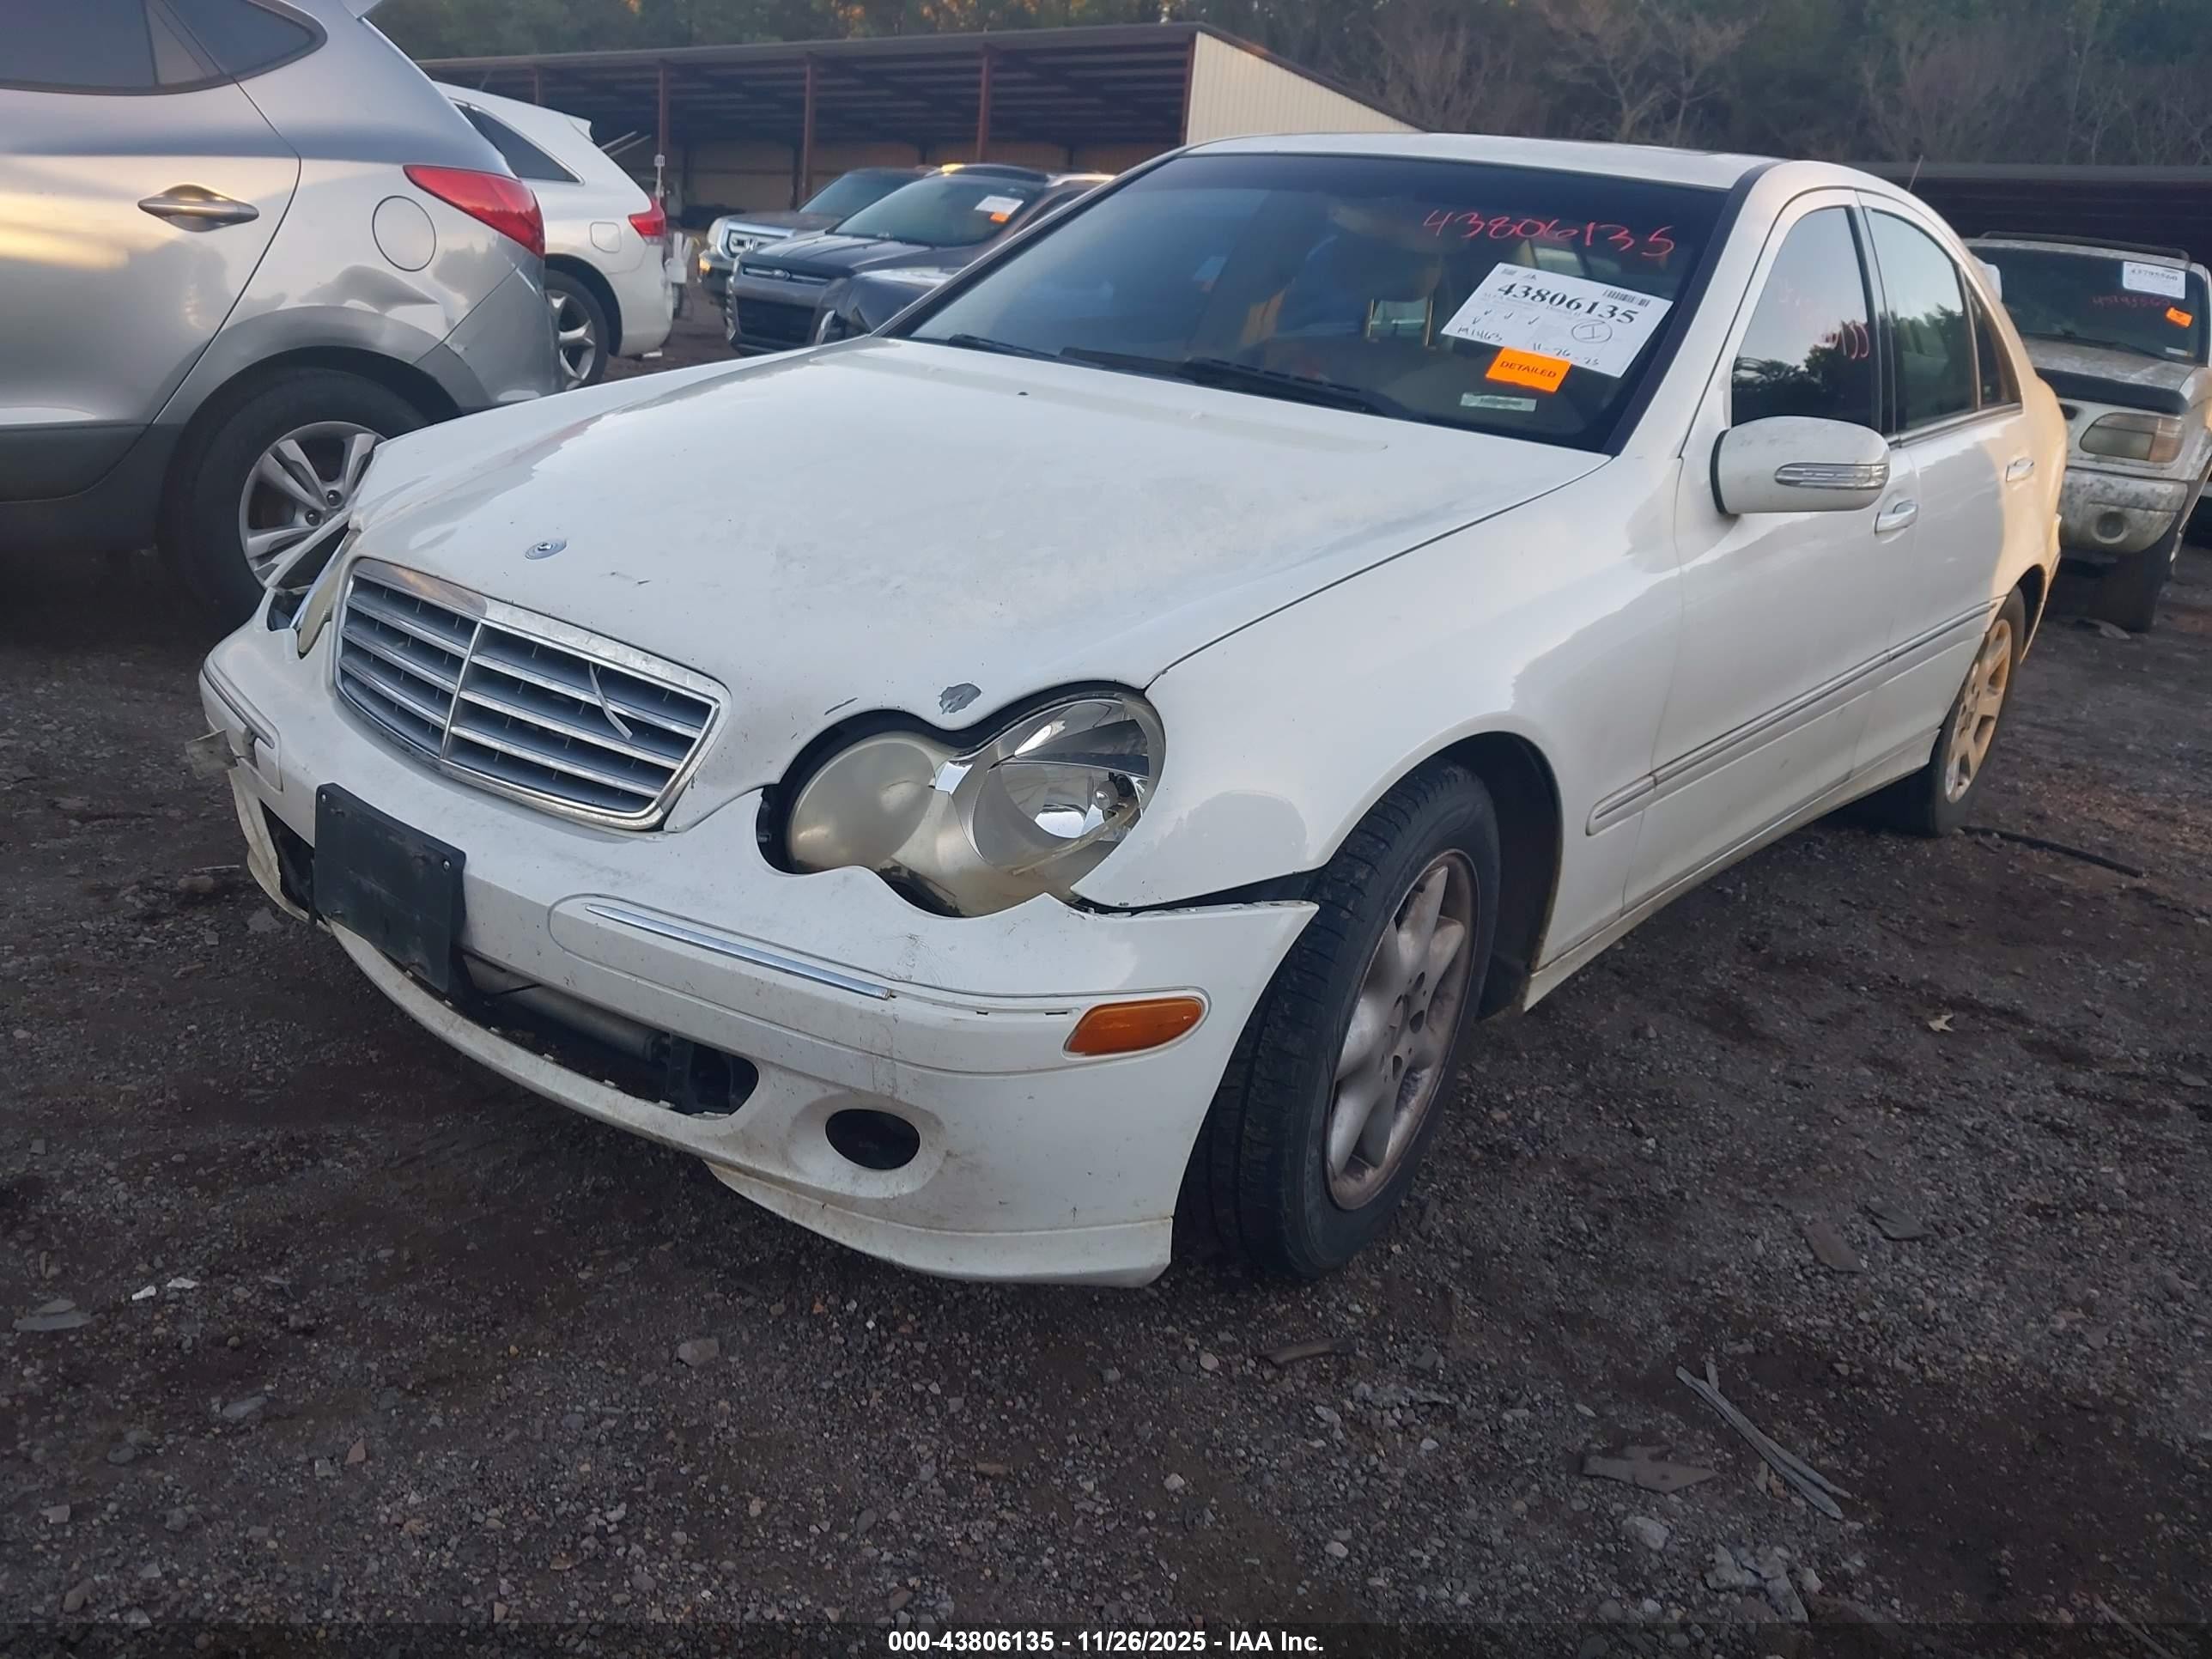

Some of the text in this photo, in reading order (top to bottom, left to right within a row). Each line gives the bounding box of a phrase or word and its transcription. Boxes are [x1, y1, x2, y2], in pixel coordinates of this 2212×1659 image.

[1422, 209, 1674, 257] 43806135
[1498, 282, 1639, 324] 43806135
[1499, 360, 1557, 379] DETAILED
